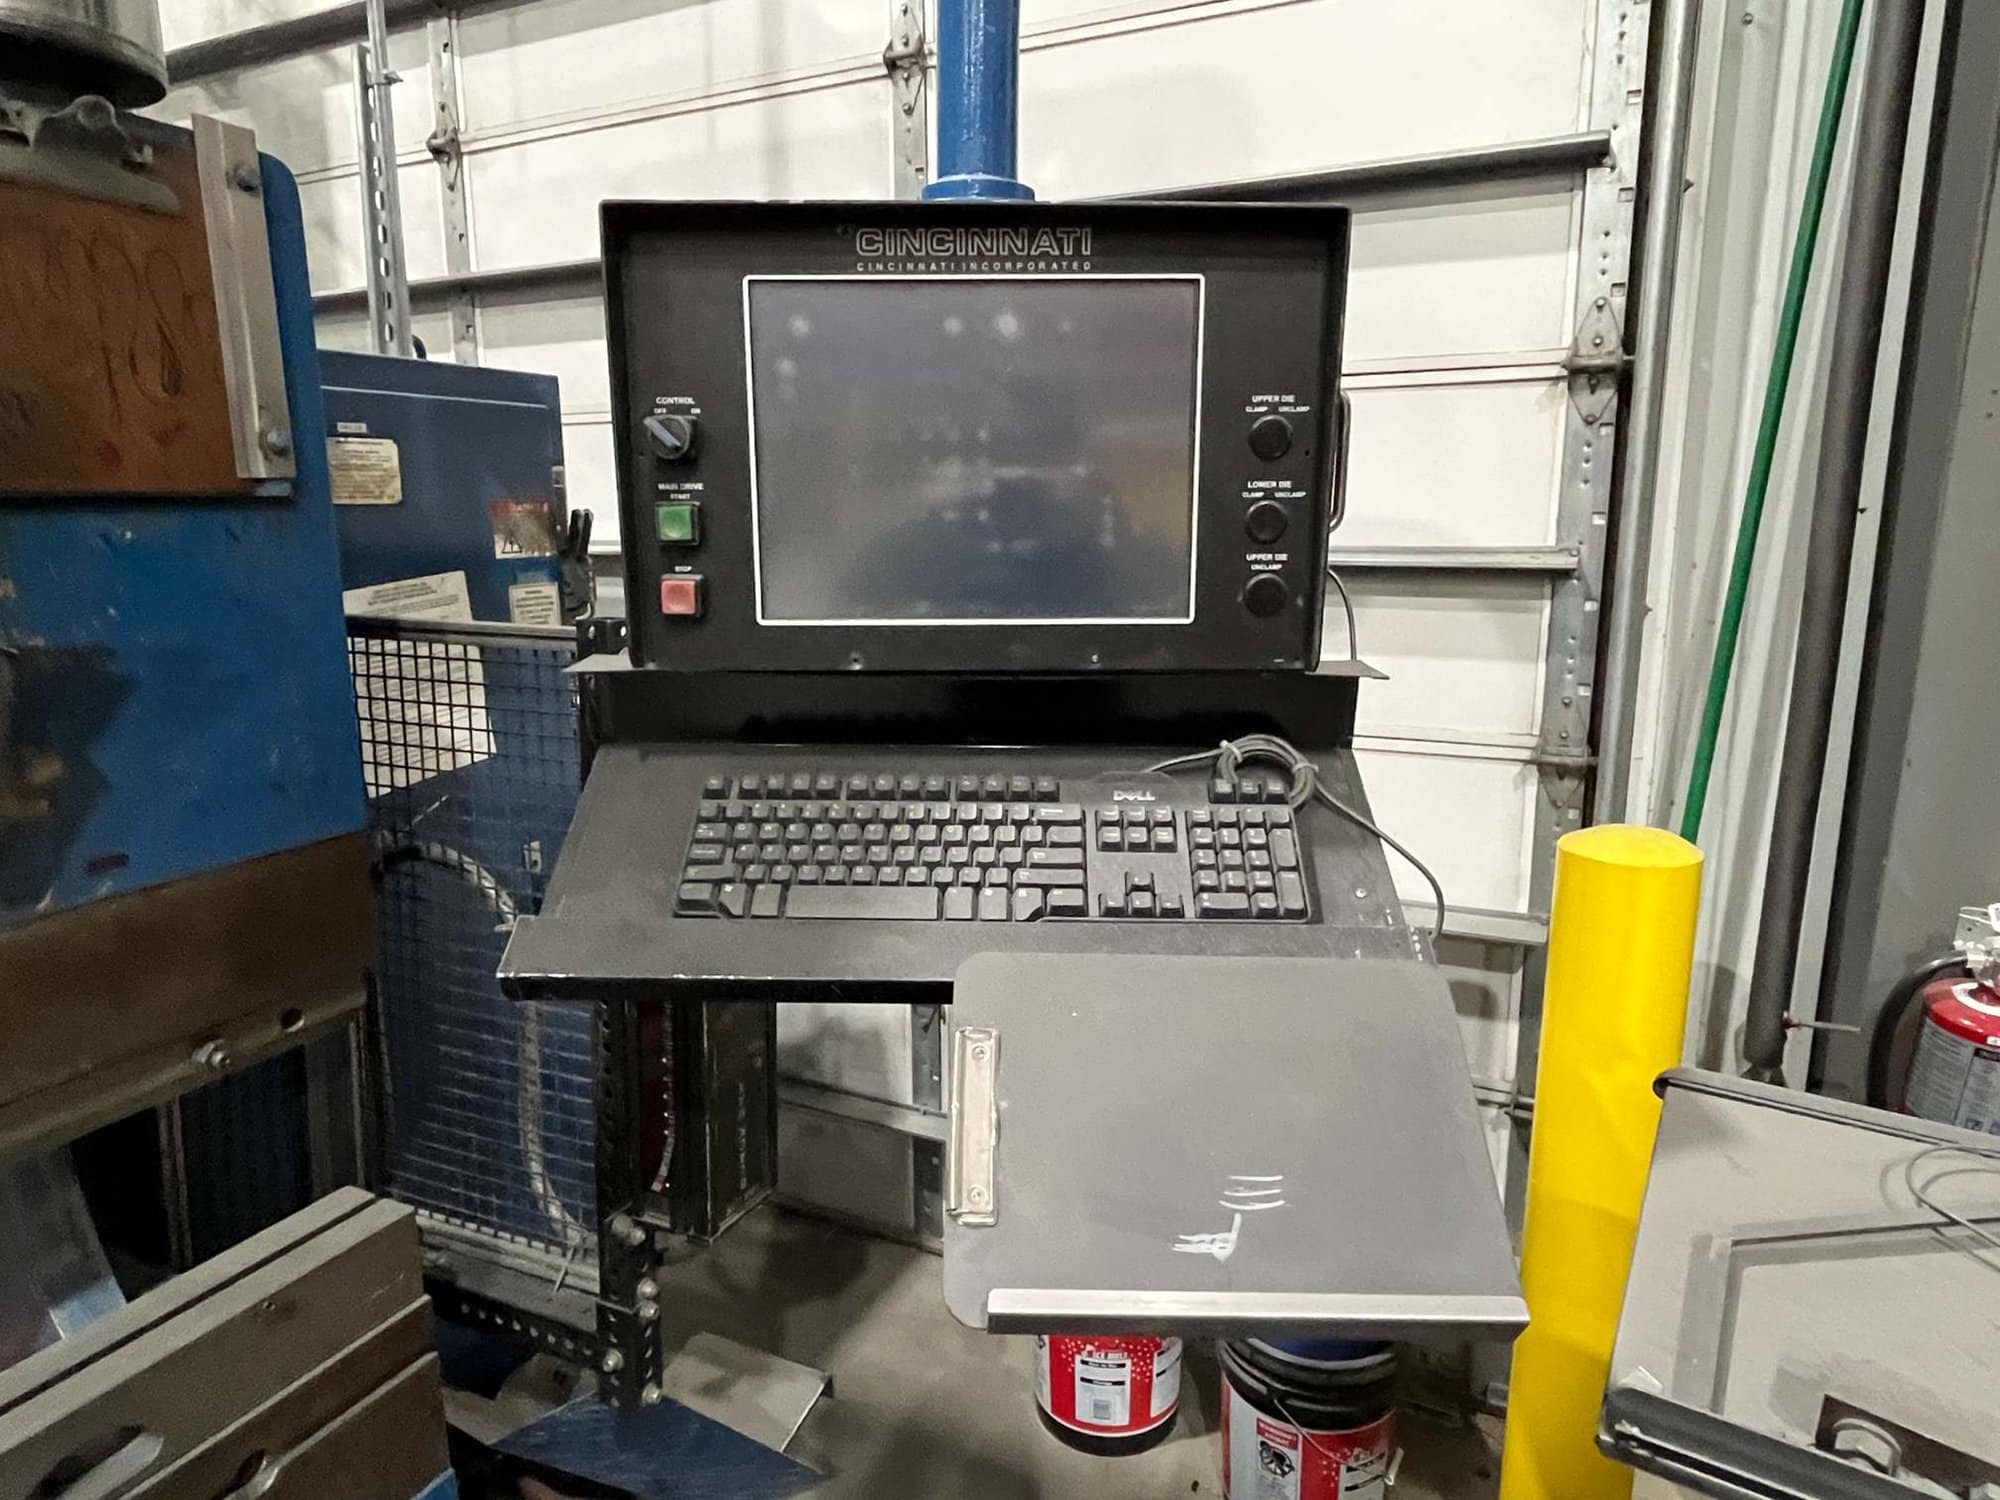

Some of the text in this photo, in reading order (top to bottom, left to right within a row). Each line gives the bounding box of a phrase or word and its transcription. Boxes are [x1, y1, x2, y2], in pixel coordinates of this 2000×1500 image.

[856, 227, 1092, 256] CINCINNATI
[856, 261, 1092, 271] CINCINNATI INCORPORATED
[1113, 790, 1155, 801] DELL
